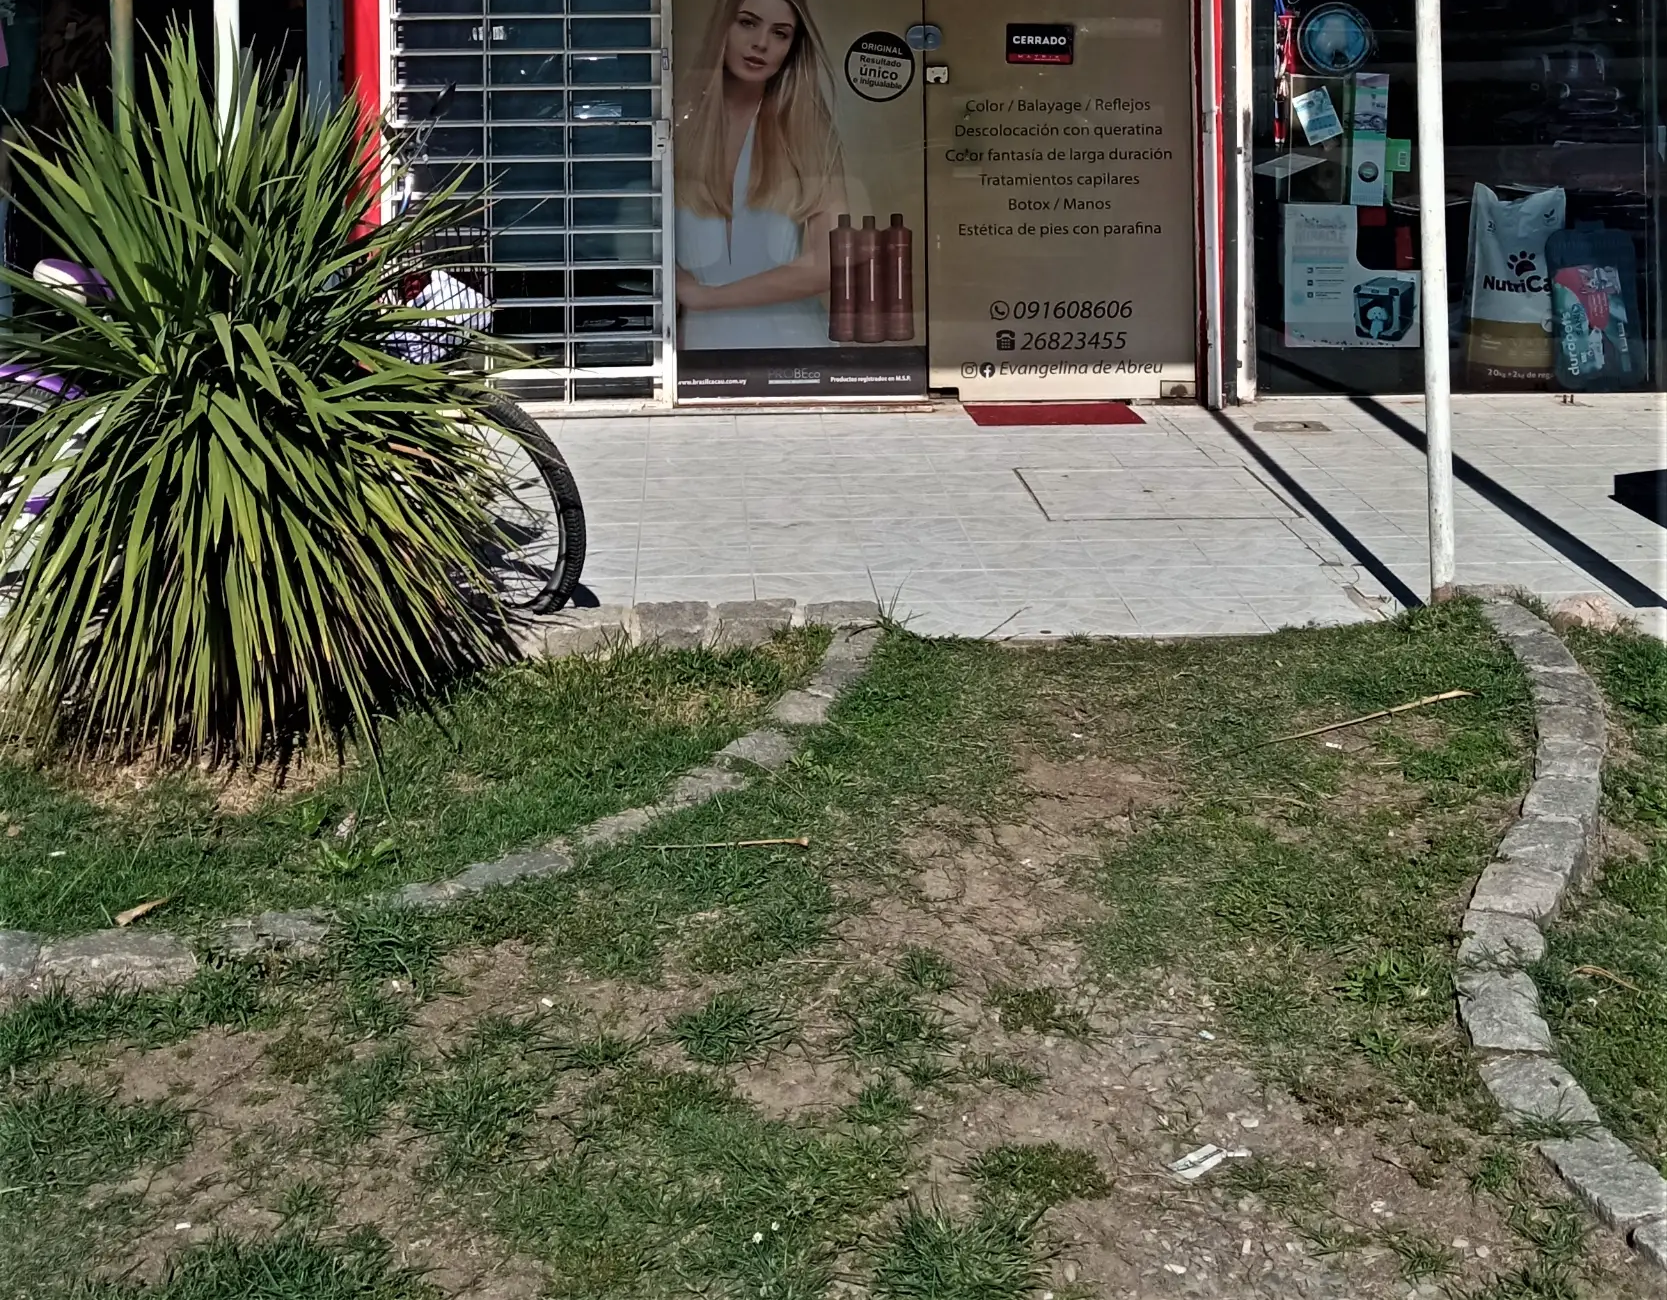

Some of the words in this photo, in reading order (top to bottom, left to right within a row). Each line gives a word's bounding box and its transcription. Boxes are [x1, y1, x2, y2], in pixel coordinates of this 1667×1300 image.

[1012, 35, 1067, 45] CERRADO
[861, 42, 903, 55] ORIGINAL
[860, 54, 902, 67] Resultado
[860, 64, 898, 81] único
[860, 77, 902, 89] inigualable
[965, 99, 1004, 113] Color
[1017, 99, 1082, 114] Balayage
[1095, 98, 1151, 113] Reflejos
[954, 123, 1059, 137] Descolocación
[1063, 126, 1090, 136] con
[1093, 123, 1163, 138] queratina
[988, 147, 1043, 162] fantasía
[1047, 148, 1066, 161] de
[1069, 147, 1105, 163] larga
[1108, 147, 1173, 161] duración
[979, 172, 1073, 186] Tratamientos
[1076, 172, 1140, 187] capilares
[1008, 198, 1050, 211] Botox
[1063, 198, 1111, 210] Manos
[958, 222, 1013, 236] Estética
[1017, 222, 1035, 236] de
[1040, 222, 1069, 238] pies
[1072, 225, 1099, 235] con
[1103, 221, 1162, 237] parafina
[1013, 300, 1133, 319] 091608606
[1020, 331, 1128, 350] 26823455
[999, 360, 1088, 378] Evangelina
[1092, 360, 1111, 374] de
[1114, 359, 1163, 374] Abreu
[858, 376, 888, 384] registrados
